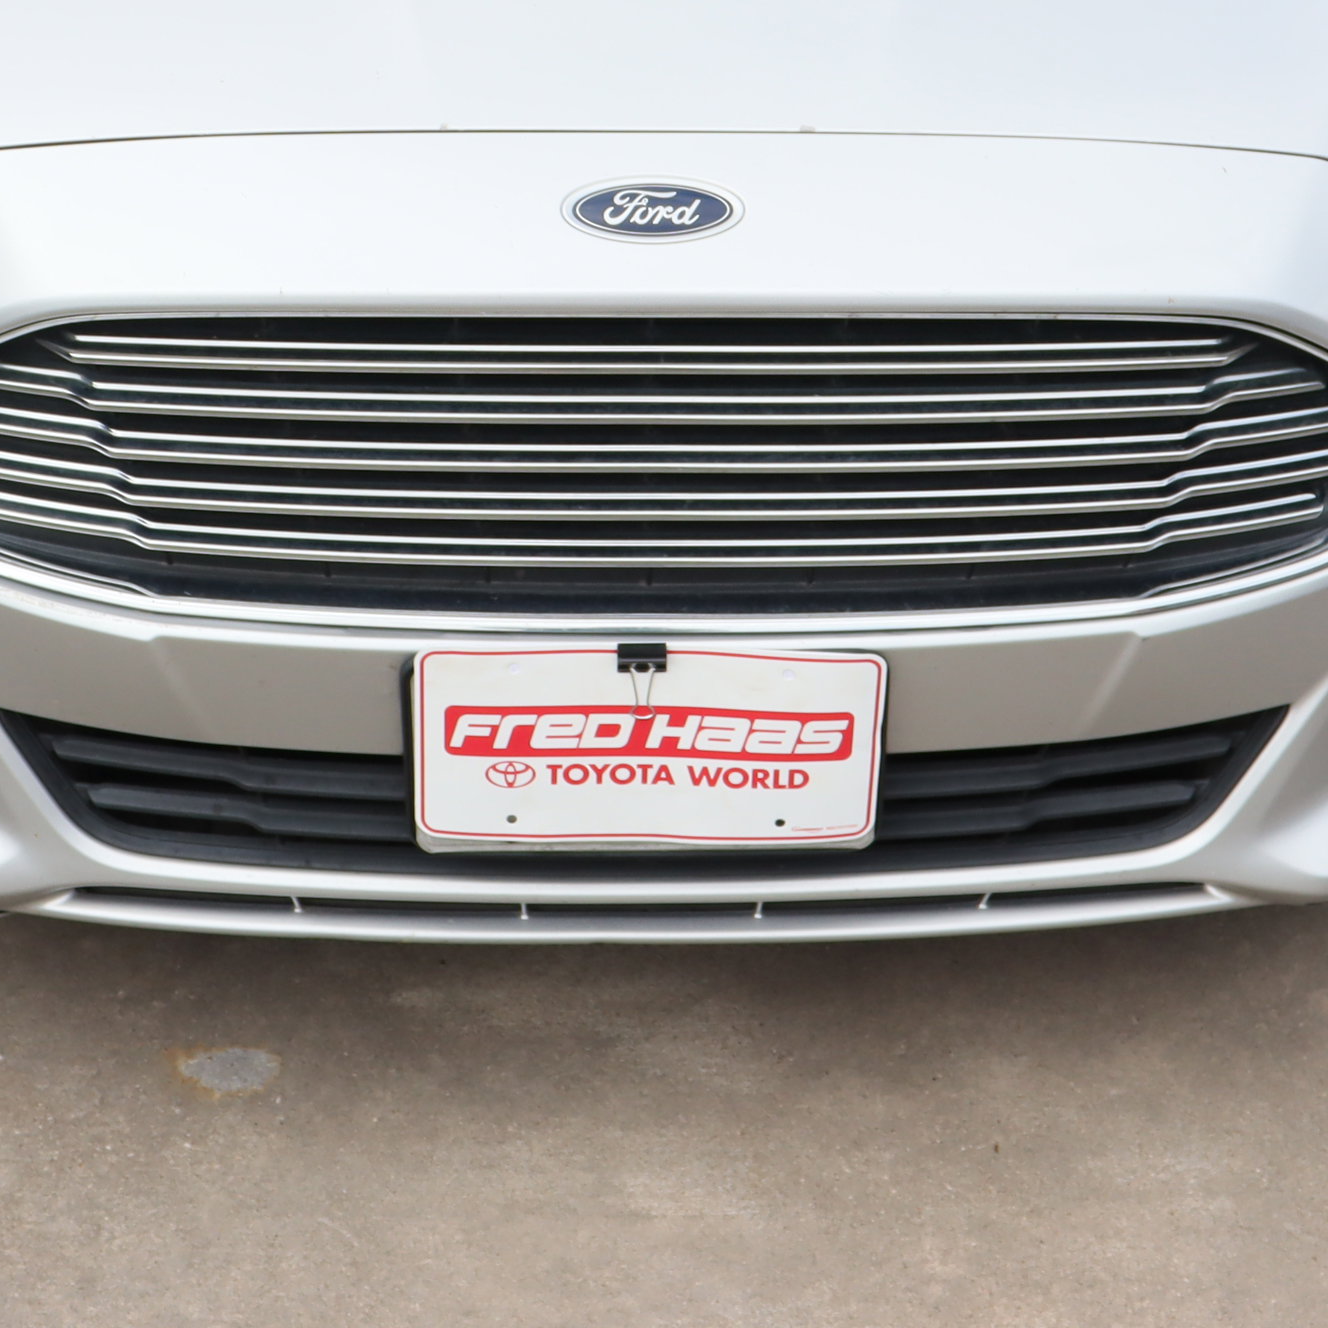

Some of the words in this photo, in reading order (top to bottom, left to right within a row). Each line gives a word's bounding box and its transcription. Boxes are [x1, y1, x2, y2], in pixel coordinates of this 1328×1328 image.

[603, 189, 701, 225] Ford
[546, 762, 676, 787] TOYOTA
[687, 765, 810, 790] WORLD
